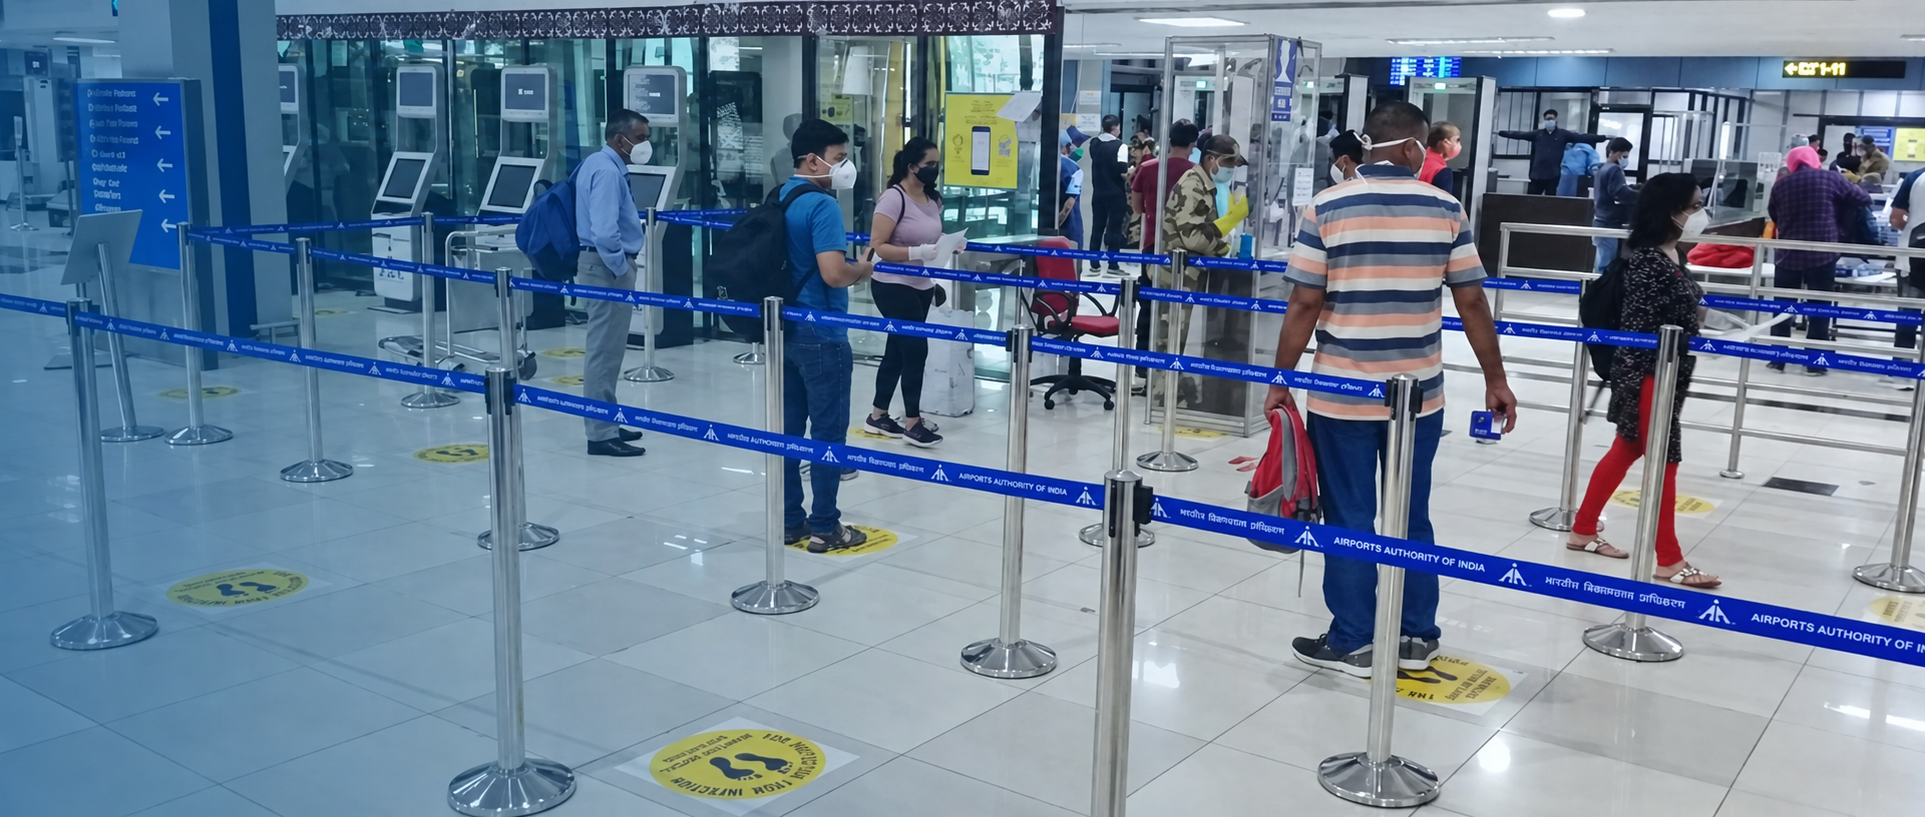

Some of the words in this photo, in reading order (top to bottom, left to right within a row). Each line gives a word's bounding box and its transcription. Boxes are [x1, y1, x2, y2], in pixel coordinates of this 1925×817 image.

[959, 473, 992, 484] AIRPORTS
[993, 478, 1034, 490] AUTHORITY
[1035, 484, 1046, 492] OF
[1047, 486, 1067, 495] INDIA
[1333, 536, 1382, 553] AIRPORTS
[1383, 546, 1440, 564] AUTHORITY
[1441, 557, 1456, 566] OF
[1458, 559, 1486, 572] INDIA
[1751, 613, 1815, 633] AIRPORTS
[1817, 625, 1893, 647] AUTHORITY
[1894, 639, 1914, 650] OF
